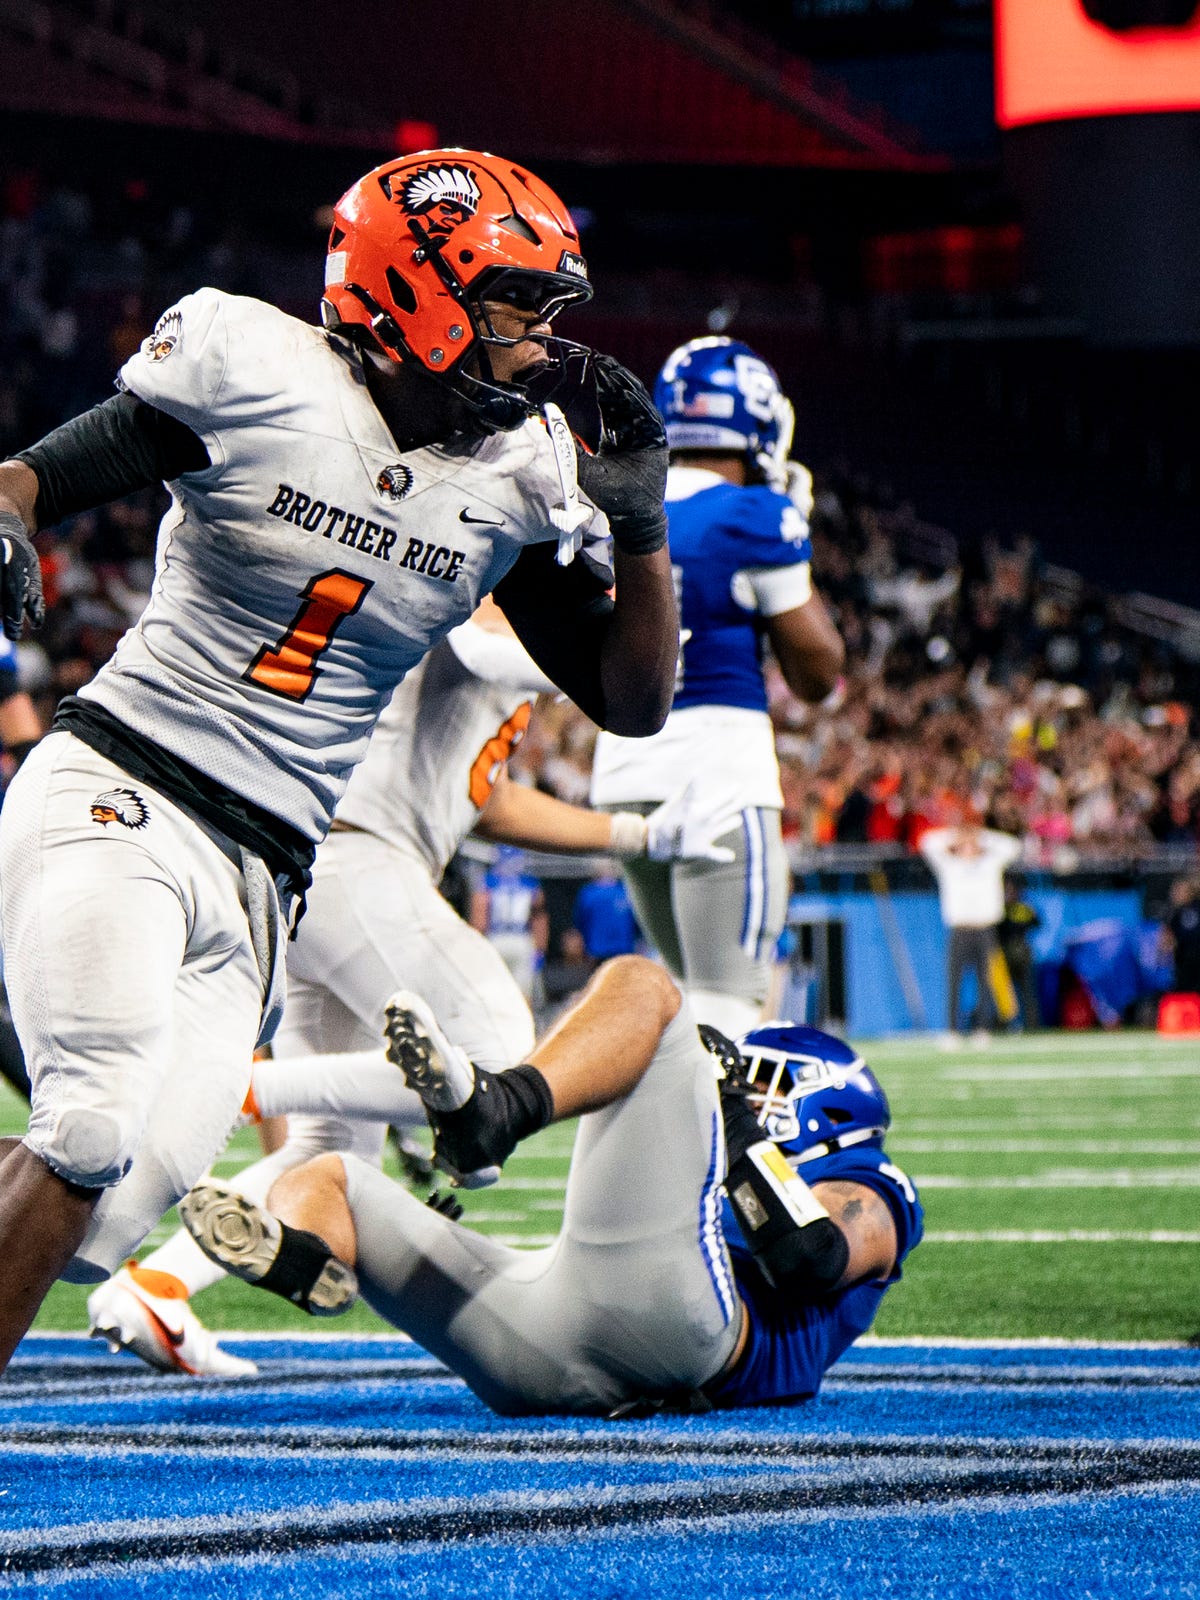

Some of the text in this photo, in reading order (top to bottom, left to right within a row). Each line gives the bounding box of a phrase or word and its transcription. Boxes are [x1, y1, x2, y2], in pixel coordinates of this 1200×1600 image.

[266, 483, 466, 582] BROTHER RICE
[240, 566, 375, 705] 1
